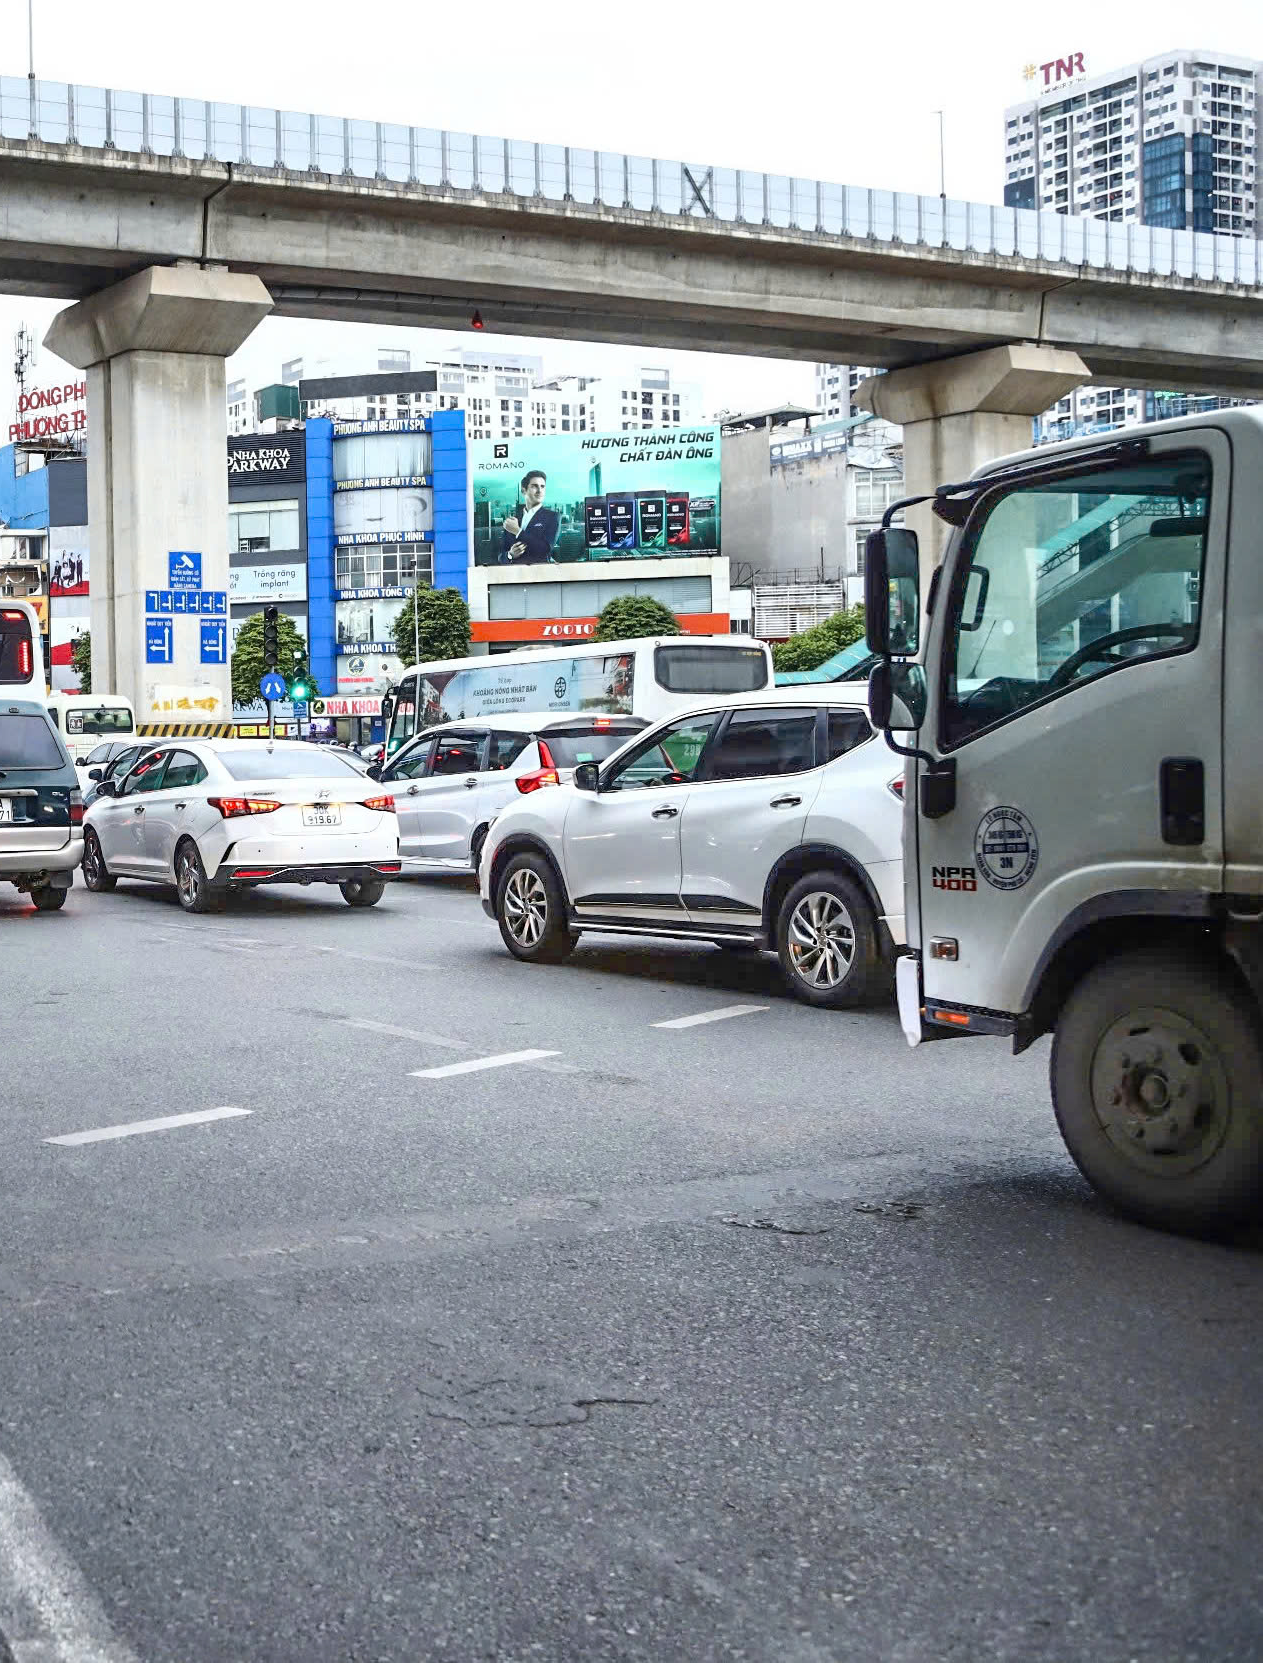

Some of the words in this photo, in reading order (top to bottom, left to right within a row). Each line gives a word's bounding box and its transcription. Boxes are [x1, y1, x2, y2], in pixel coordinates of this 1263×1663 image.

[1040, 52, 1085, 85] TNR
[363, 419, 378, 432] ANH
[379, 419, 410, 431] BEAUTY
[410, 419, 426, 431] SPA
[581, 436, 630, 449] HƯƠNG
[633, 432, 676, 446] THÀNH
[679, 430, 714, 444] CÔNG
[233, 450, 257, 460] NHA
[258, 448, 290, 459] KHOA
[620, 446, 653, 463] CHẤT
[655, 447, 683, 461] ĐÀN
[686, 446, 714, 459] ÔNG
[227, 456, 291, 473] PARKWAY
[478, 461, 525, 470] ROMANO
[364, 478, 379, 487] ANH
[381, 477, 409, 487] BEAUTY
[411, 476, 426, 486] SPA
[338, 535, 354, 545] NHA
[356, 533, 378, 543] KHOA
[380, 532, 403, 543] PHỤC
[278, 569, 296, 578] răng
[260, 579, 289, 589] implant
[341, 590, 356, 599] NHA
[358, 588, 379, 598] KHOA
[343, 644, 359, 655] NHA
[360, 643, 383, 654] KHOA
[233, 702, 264, 712] RKWA
[327, 700, 349, 715] NHA
[349, 700, 380, 714] KHOA
[1000, 857, 1013, 868] 3N
[932, 867, 976, 879] NPR
[932, 879, 977, 891] 400
